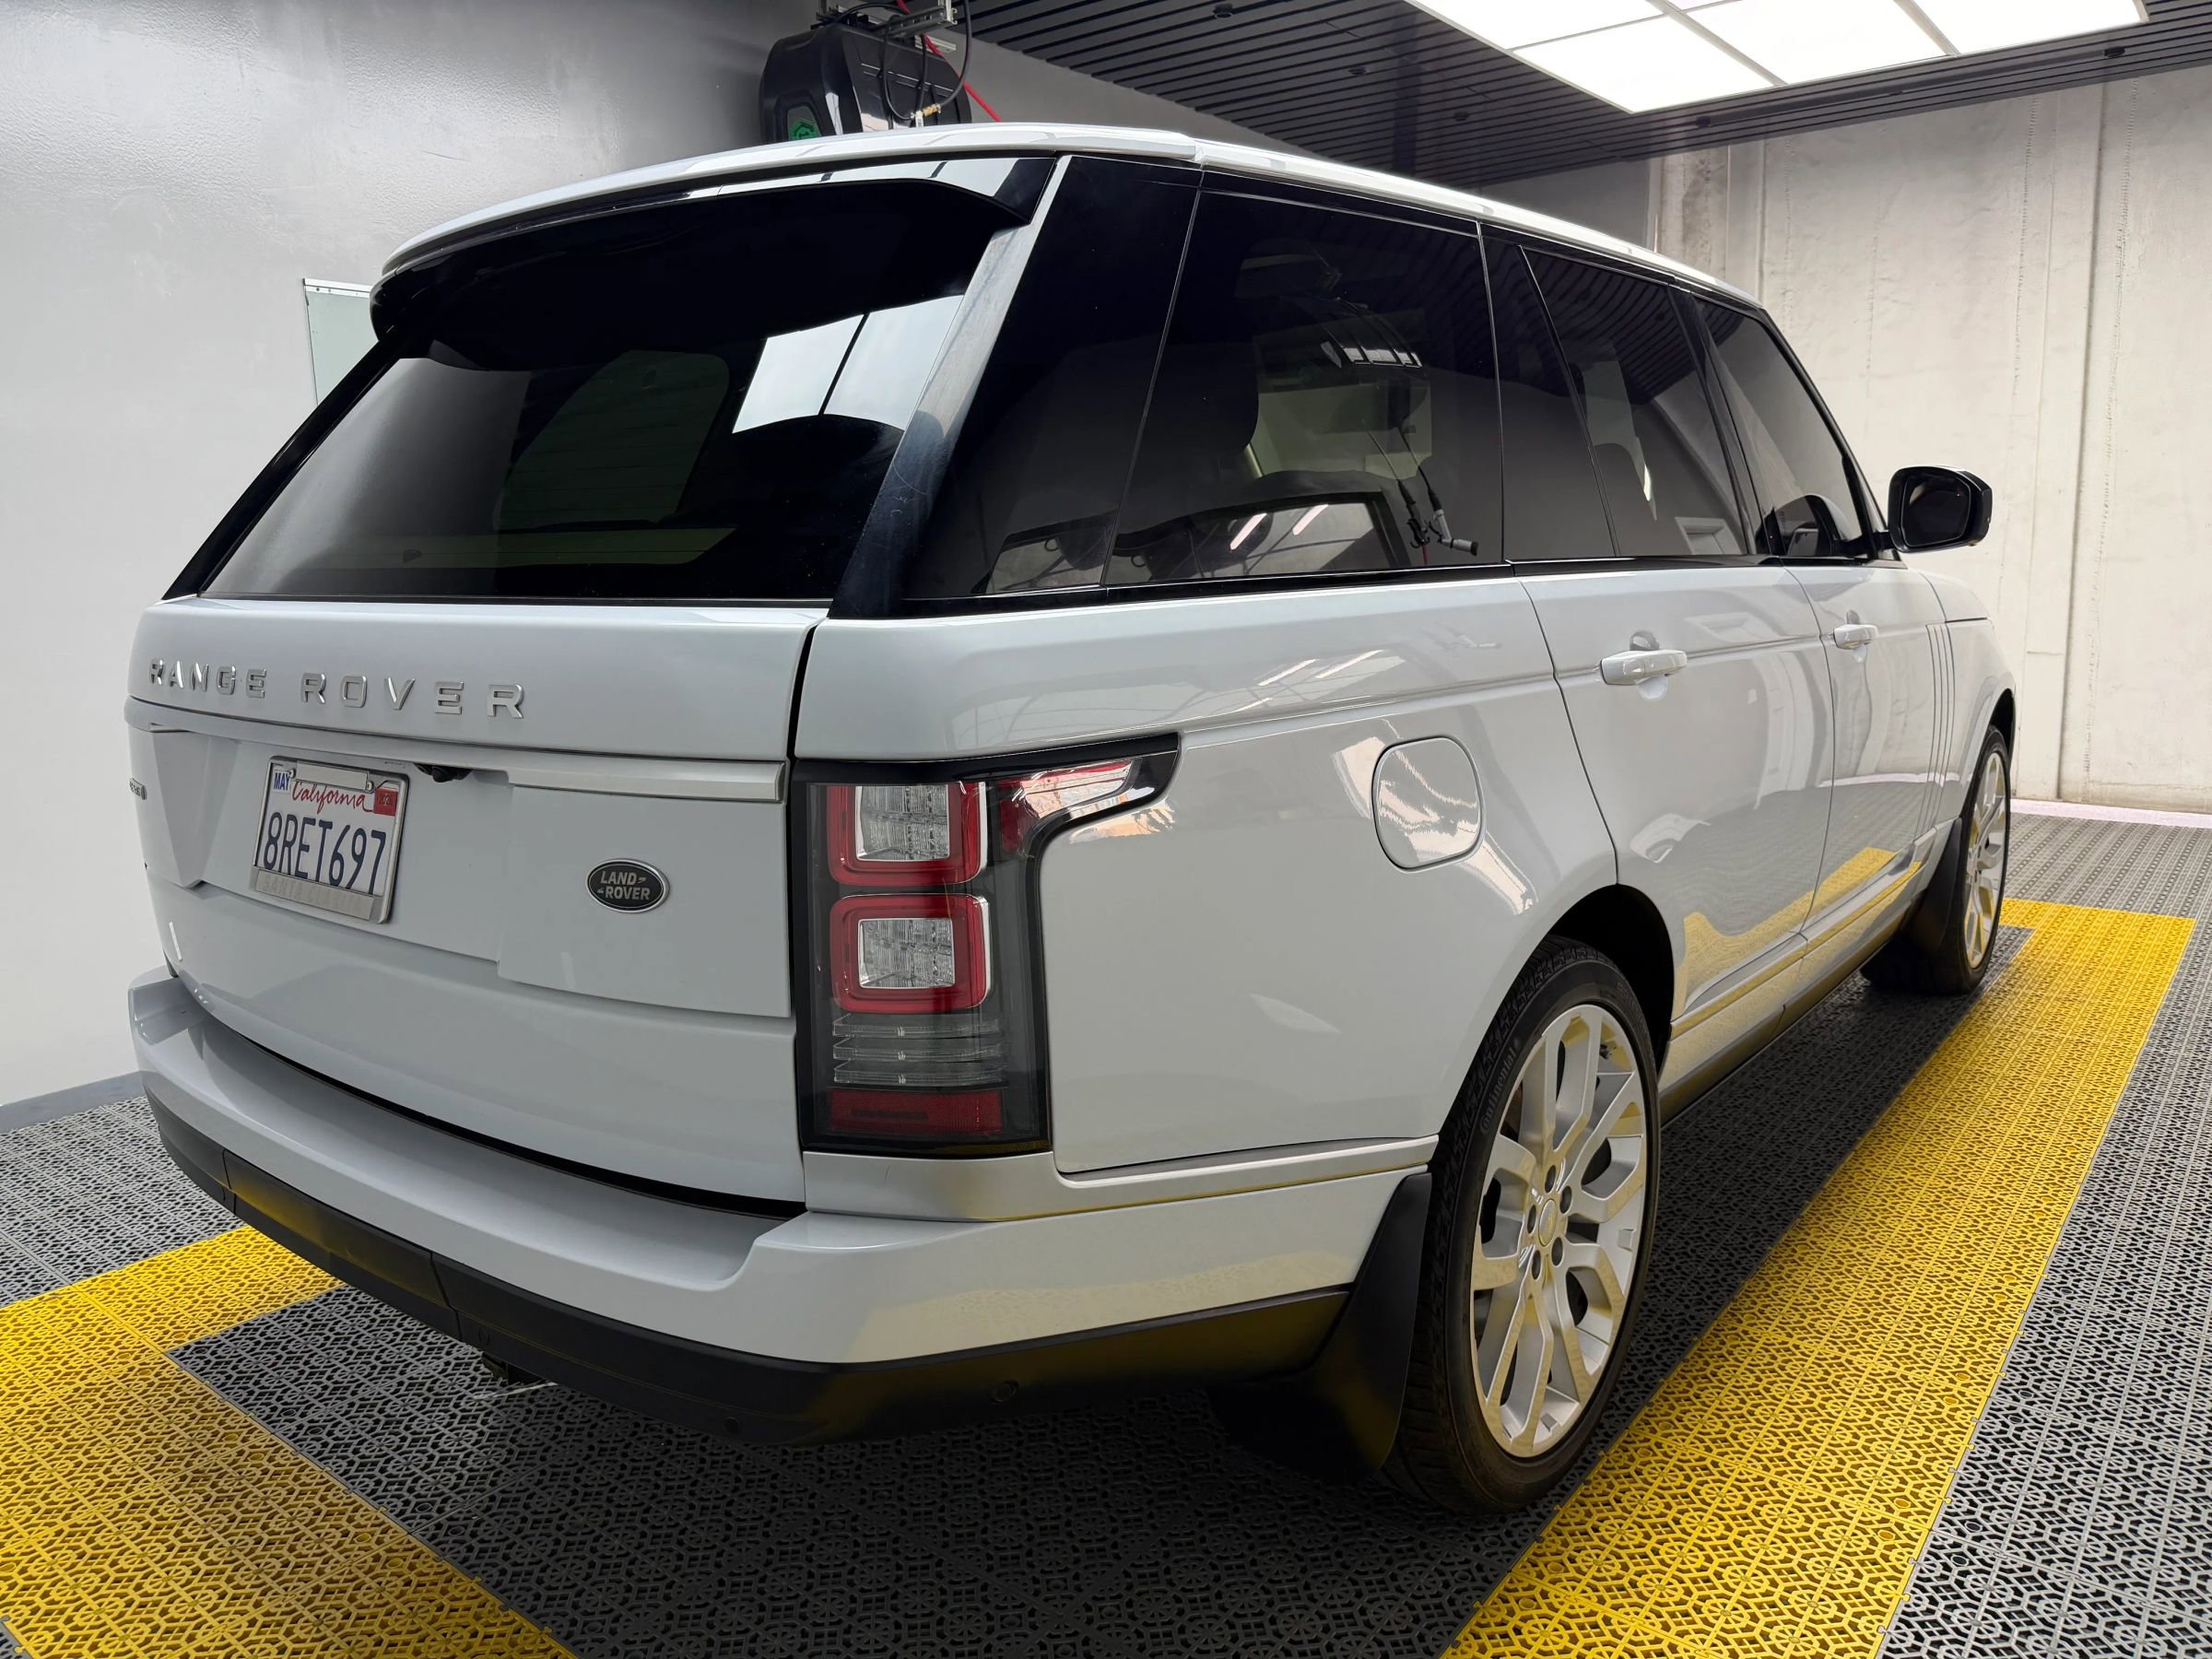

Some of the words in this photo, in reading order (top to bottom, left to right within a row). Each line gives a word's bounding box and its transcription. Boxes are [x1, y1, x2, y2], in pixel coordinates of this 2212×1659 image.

[148, 658, 267, 699] RANGE
[300, 672, 524, 719] ROVER
[274, 772, 290, 791] MAY
[291, 781, 373, 814] California
[263, 812, 386, 895] 8RET697
[600, 871, 636, 885] LAND
[606, 886, 650, 900] ROVER
[1478, 1045, 1517, 1135] Continental
